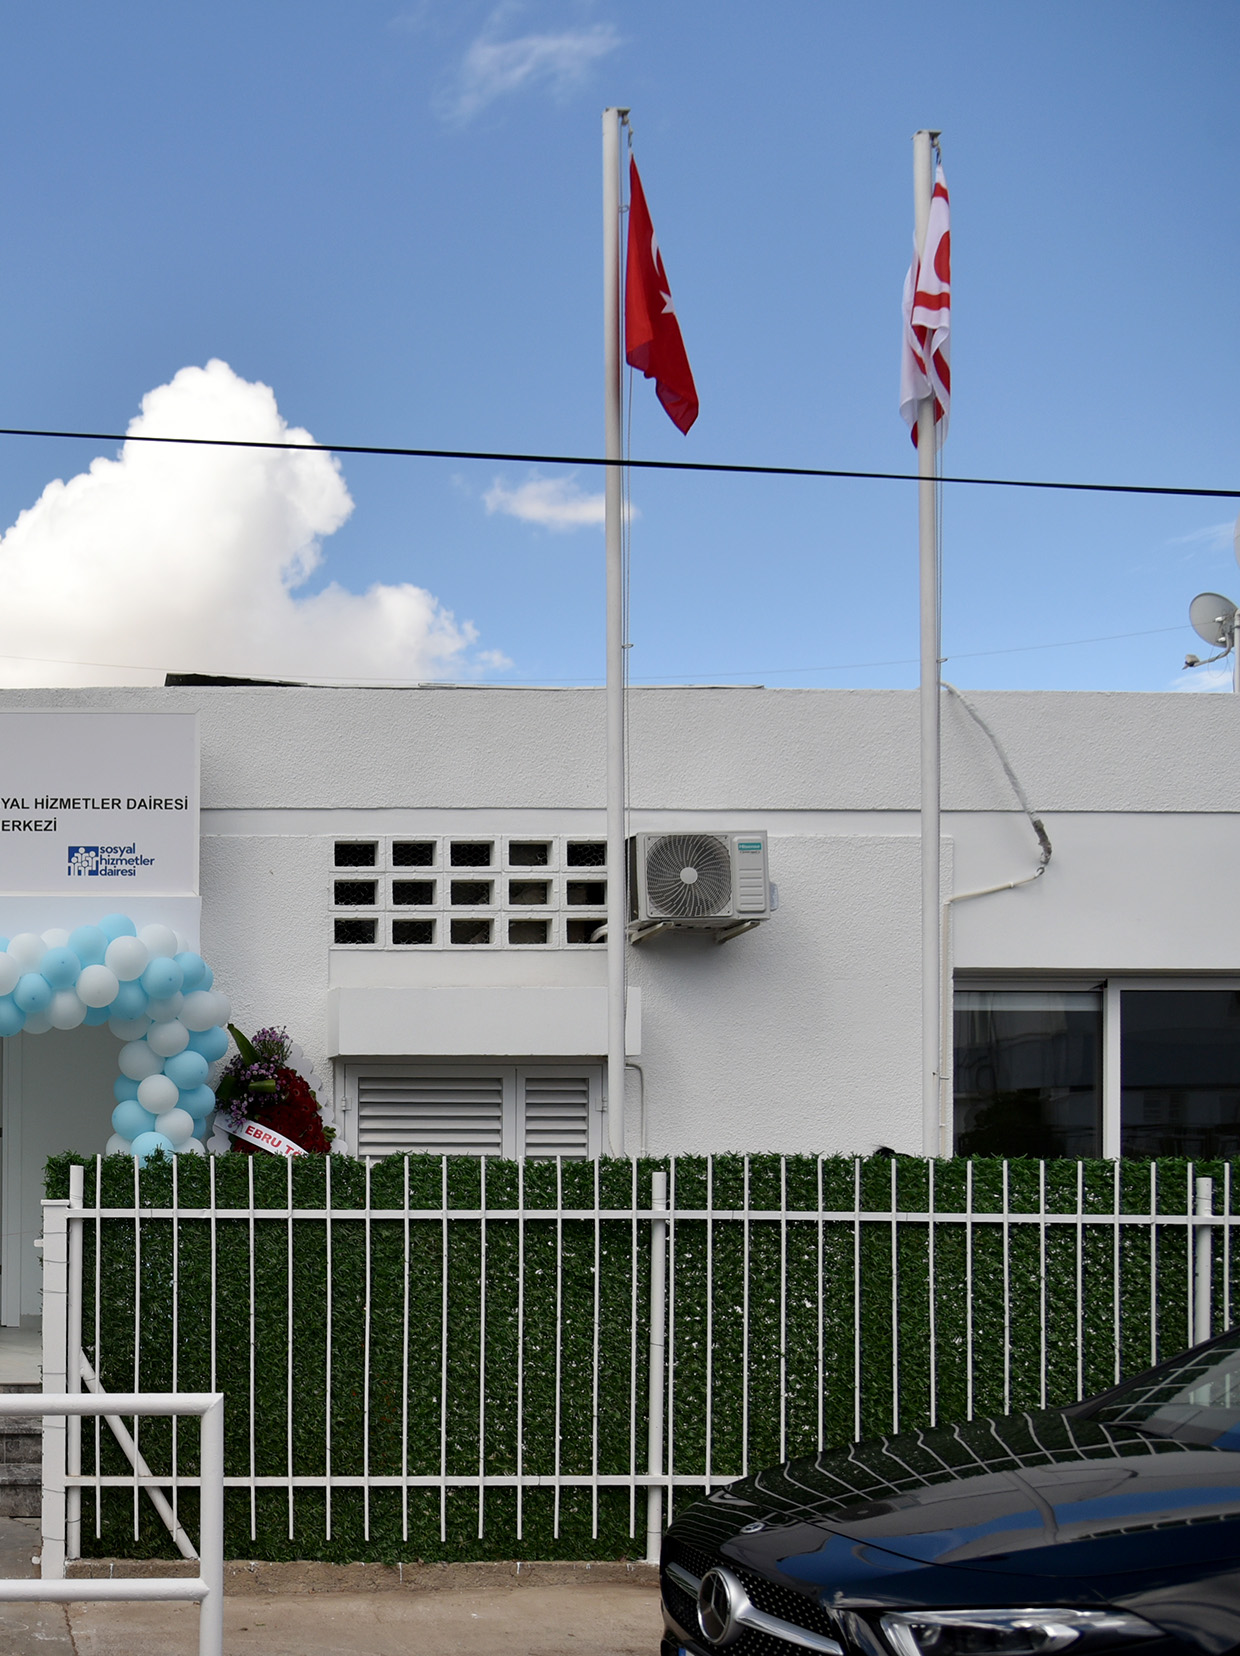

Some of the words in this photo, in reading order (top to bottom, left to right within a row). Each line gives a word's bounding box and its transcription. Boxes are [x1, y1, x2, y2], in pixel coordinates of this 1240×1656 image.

[34, 795, 122, 810] HİZMETLER
[126, 795, 189, 810] DAİRESİ
[100, 842, 136, 857] sosyal
[100, 854, 155, 866] hizmetler
[99, 865, 136, 876] dairesi
[244, 1125, 282, 1148] EBRU
